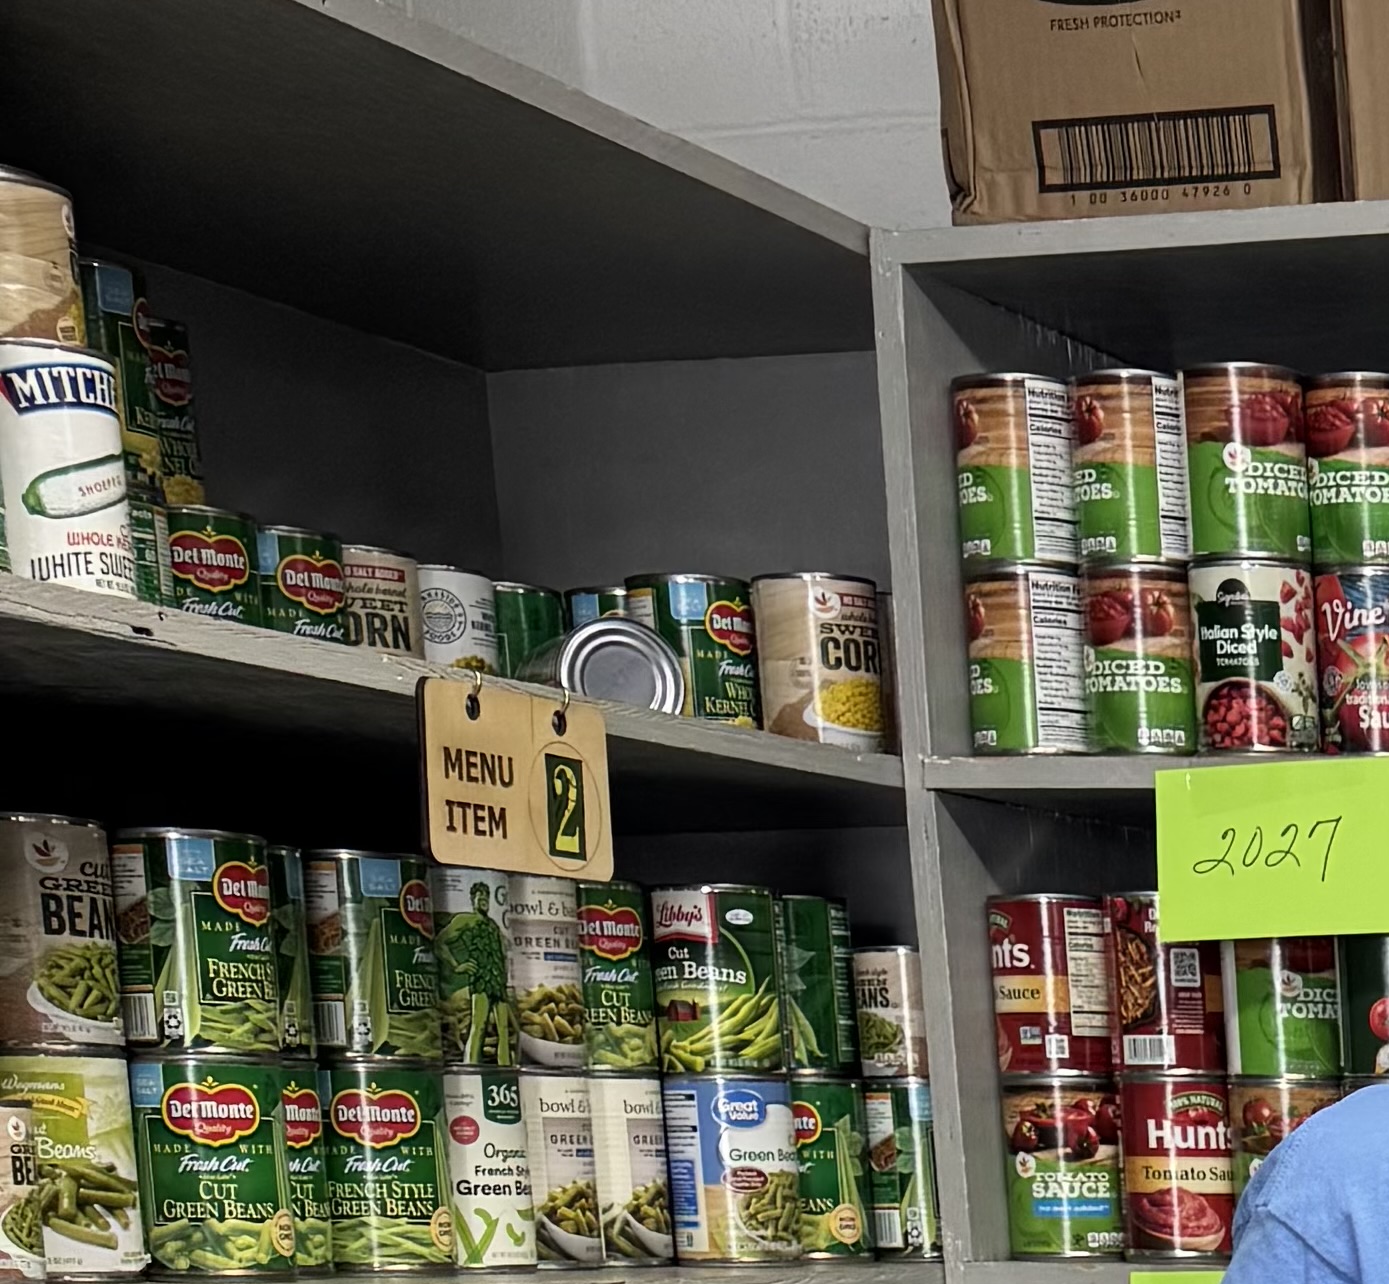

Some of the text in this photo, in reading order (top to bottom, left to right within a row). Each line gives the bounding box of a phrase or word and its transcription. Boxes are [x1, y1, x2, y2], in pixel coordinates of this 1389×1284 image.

[1321, 599, 1385, 642] Vine
[1216, 639, 1257, 655] Diced
[443, 746, 514, 788] MENU
[445, 800, 508, 839] ITEM
[553, 764, 580, 855] 2
[1192, 814, 1342, 882] 2027
[668, 946, 689, 960] Cut
[683, 961, 746, 984] Beans
[601, 991, 631, 1006] CUT
[486, 1083, 519, 1107] 365
[729, 1148, 768, 1163] Green
[199, 1182, 238, 1200] CUT
[391, 1181, 435, 1198] STYLE
[162, 1199, 274, 1219] GREEN BEANS
[385, 1200, 433, 1217] BEANS
